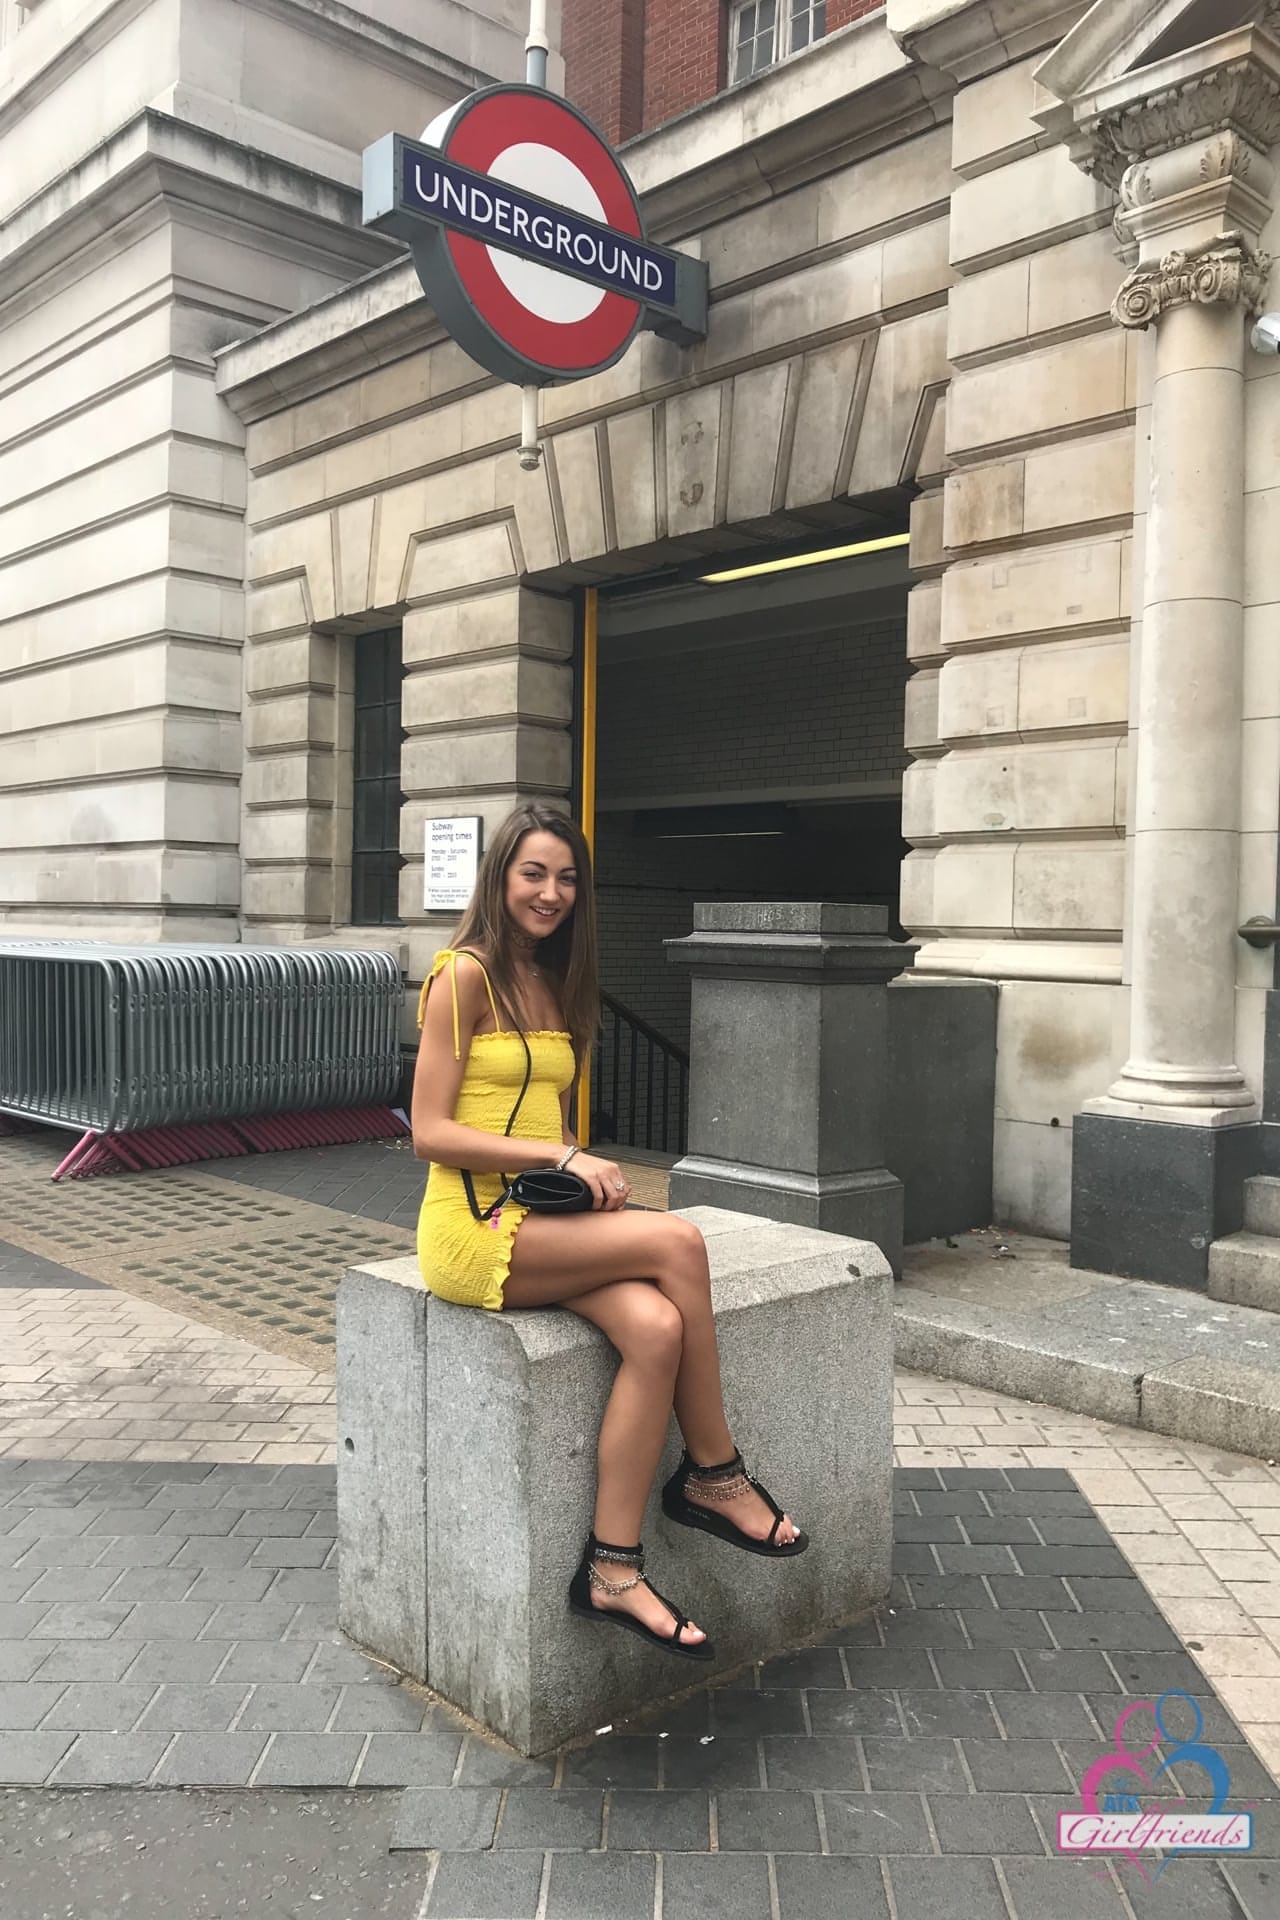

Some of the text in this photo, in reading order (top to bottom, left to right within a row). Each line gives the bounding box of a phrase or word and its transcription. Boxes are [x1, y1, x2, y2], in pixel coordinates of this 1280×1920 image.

[414, 164, 663, 292] UNDERGROUND
[432, 822, 453, 831] Subway
[432, 833, 454, 842] opening
